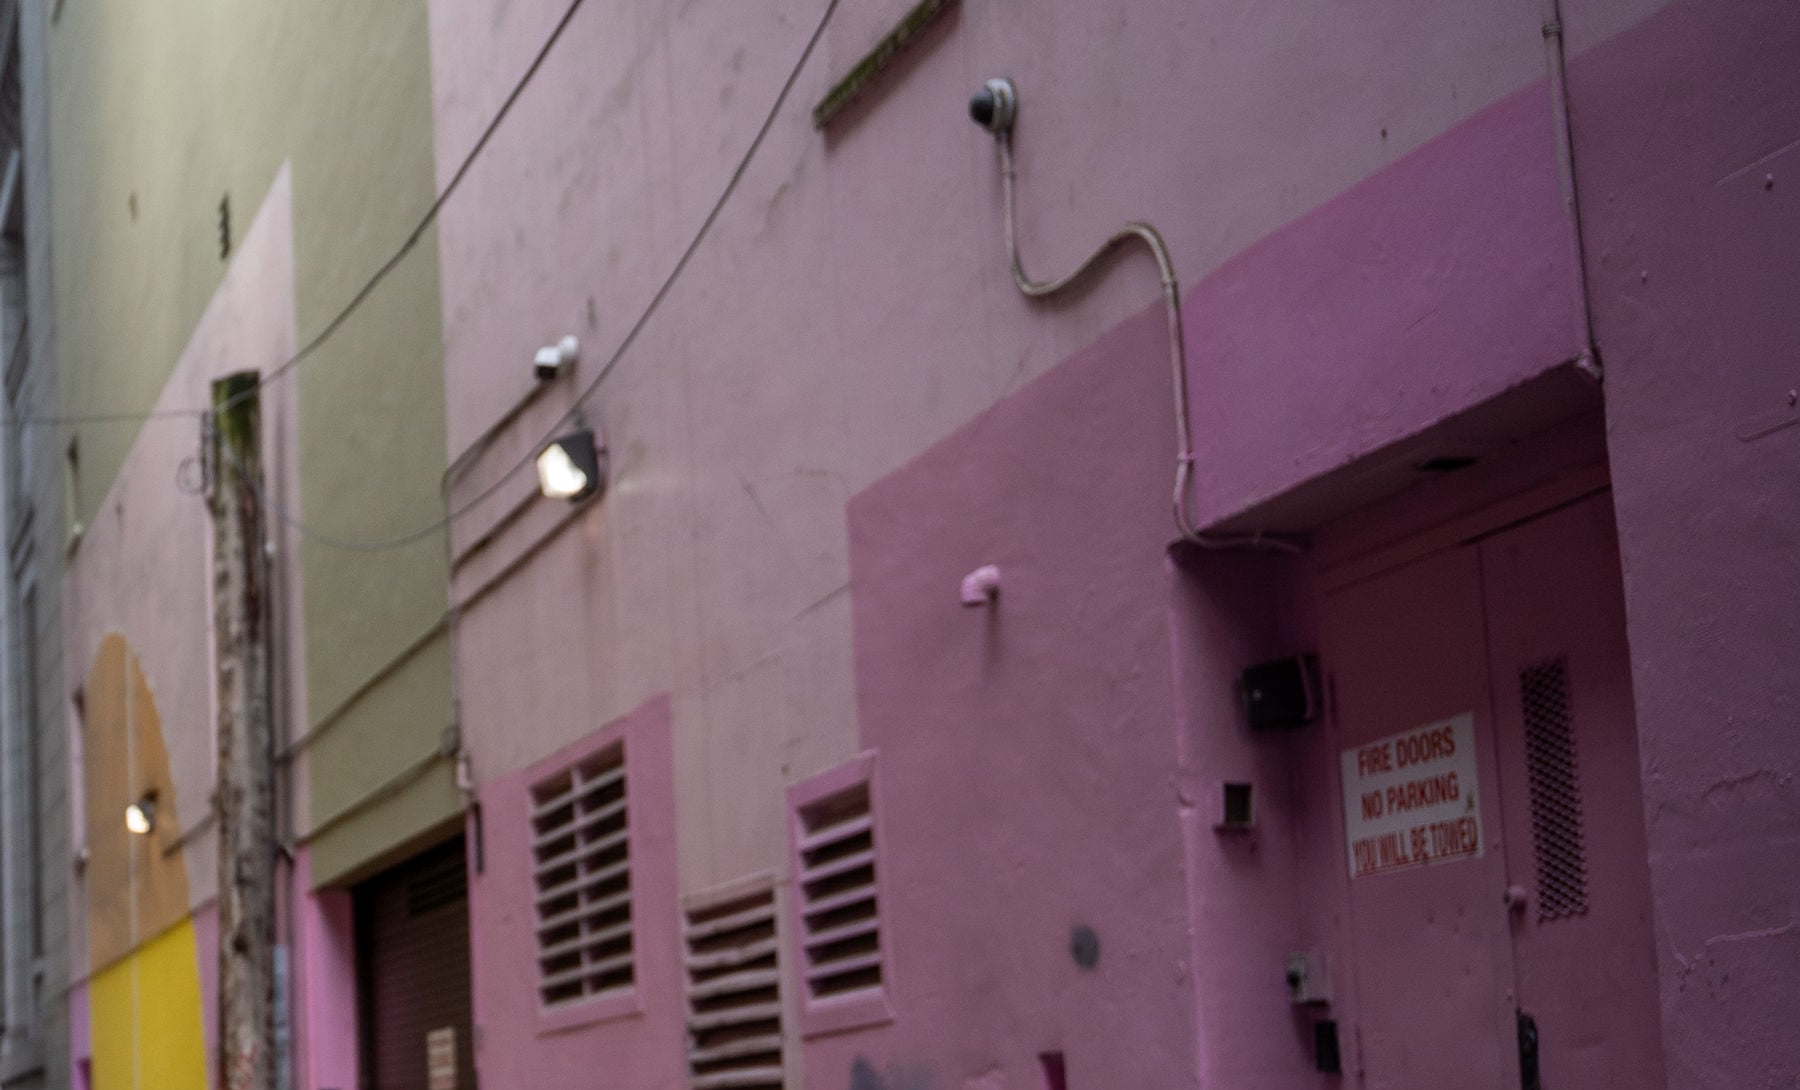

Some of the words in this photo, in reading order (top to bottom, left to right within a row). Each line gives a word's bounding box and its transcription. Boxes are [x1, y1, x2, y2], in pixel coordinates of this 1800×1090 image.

[1357, 743, 1392, 778] FIRE
[1396, 726, 1456, 769] DOORS
[1361, 789, 1384, 822] NO
[1387, 771, 1460, 815] PARKING
[1378, 830, 1410, 867] WILL
[1411, 825, 1429, 862] BE
[1430, 816, 1479, 858] TOWED
